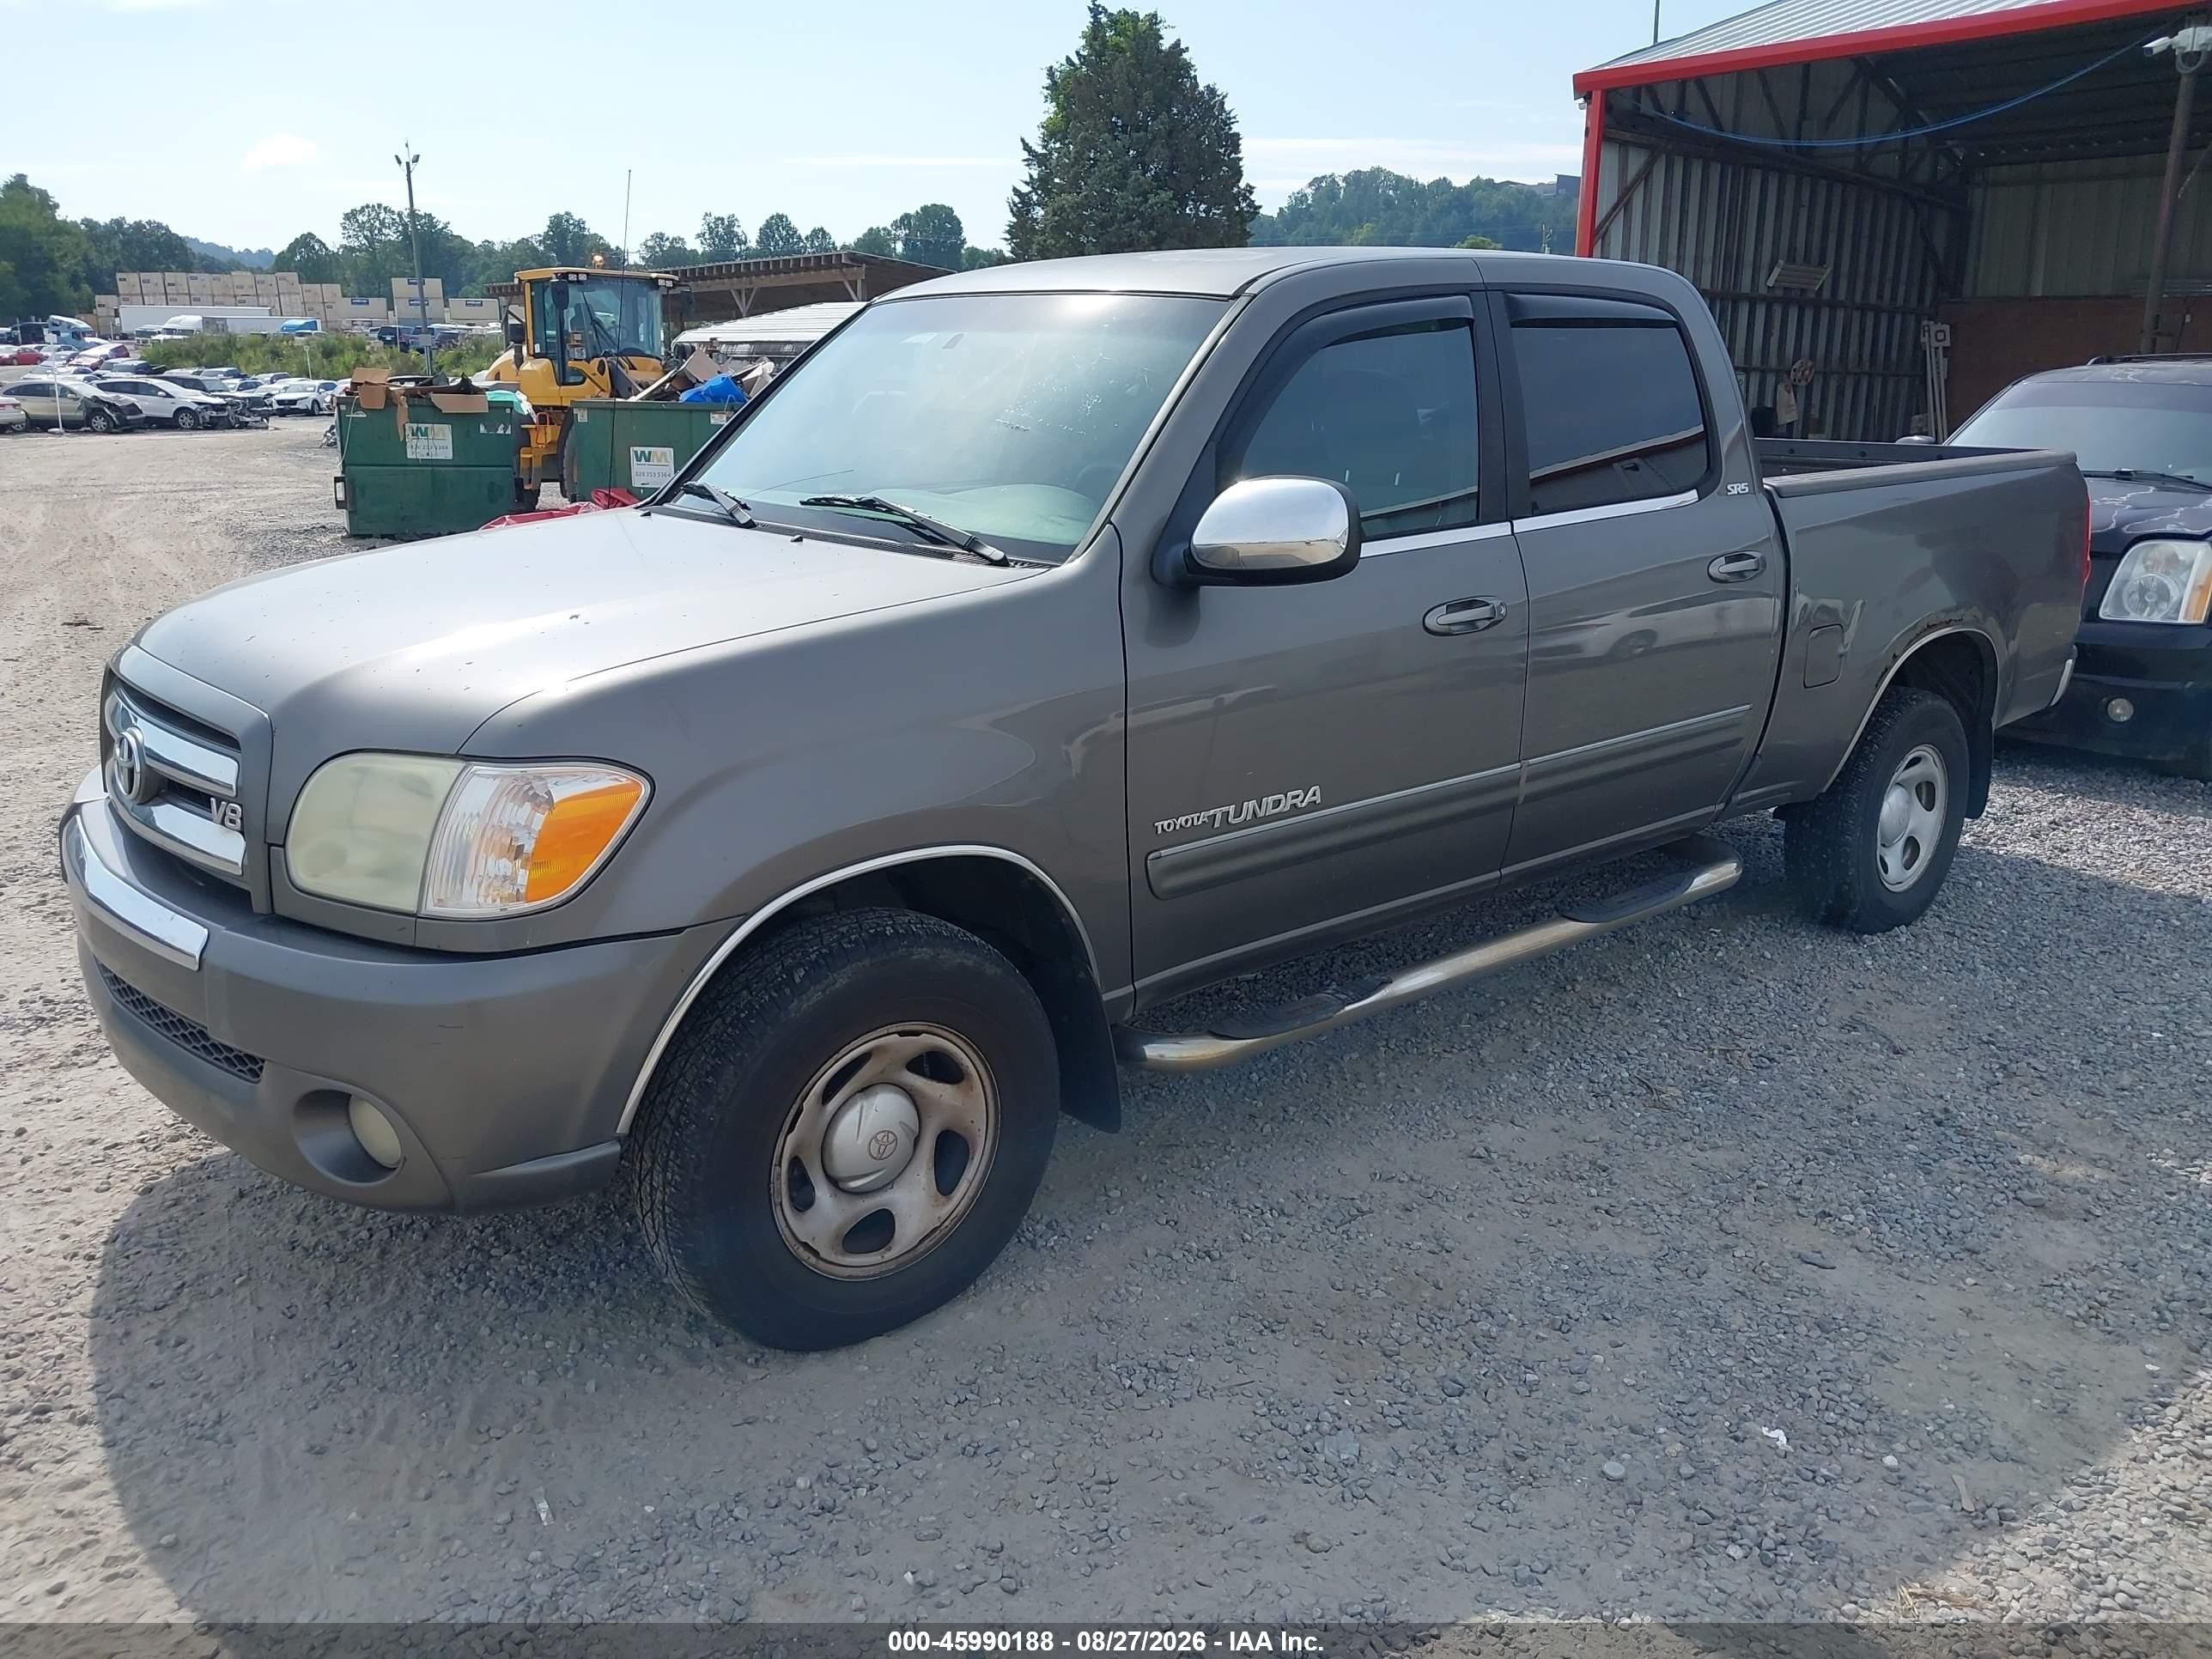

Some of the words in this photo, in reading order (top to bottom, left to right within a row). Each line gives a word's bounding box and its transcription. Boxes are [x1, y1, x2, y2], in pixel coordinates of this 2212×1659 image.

[633, 450, 669, 463] WM
[1727, 482, 1749, 495] SR5
[210, 797, 242, 831] V8
[1154, 811, 1209, 835] TOYOTA
[1209, 785, 1322, 830] TUNDRA
